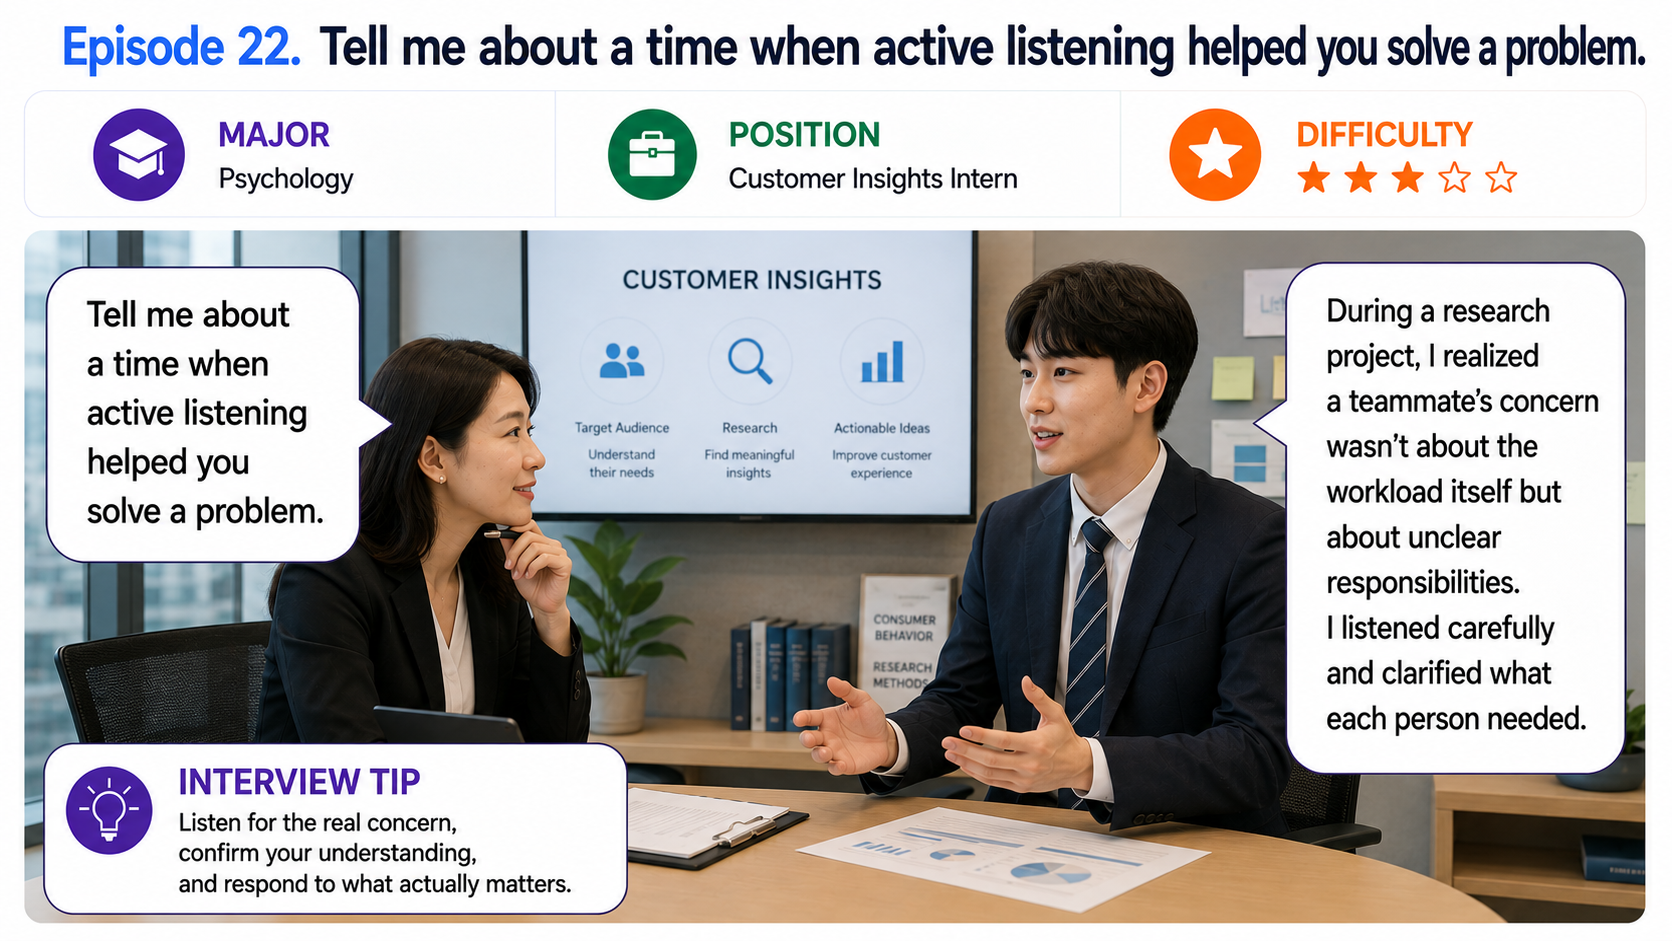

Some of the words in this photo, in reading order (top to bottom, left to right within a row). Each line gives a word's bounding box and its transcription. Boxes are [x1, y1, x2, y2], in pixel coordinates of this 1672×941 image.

[622, 269, 759, 290] CUSTOMER
[767, 269, 882, 291] INSIGHTS
[574, 421, 613, 437] Target
[615, 421, 670, 434] Audience
[722, 421, 778, 434] Research
[833, 421, 897, 434] Actionable
[899, 422, 931, 435] Ideas
[588, 448, 656, 461] Understand
[704, 448, 729, 461] Find
[731, 448, 795, 464] meaningful
[832, 449, 879, 463] Improve
[880, 450, 933, 461] customer
[589, 466, 617, 479] their
[619, 466, 655, 479] needs
[726, 466, 772, 482] insights
[850, 467, 913, 481] experience
[873, 614, 936, 625] CONSUMER
[875, 630, 934, 641] BEHAVIOR
[873, 661, 932, 673] RESEARCH
